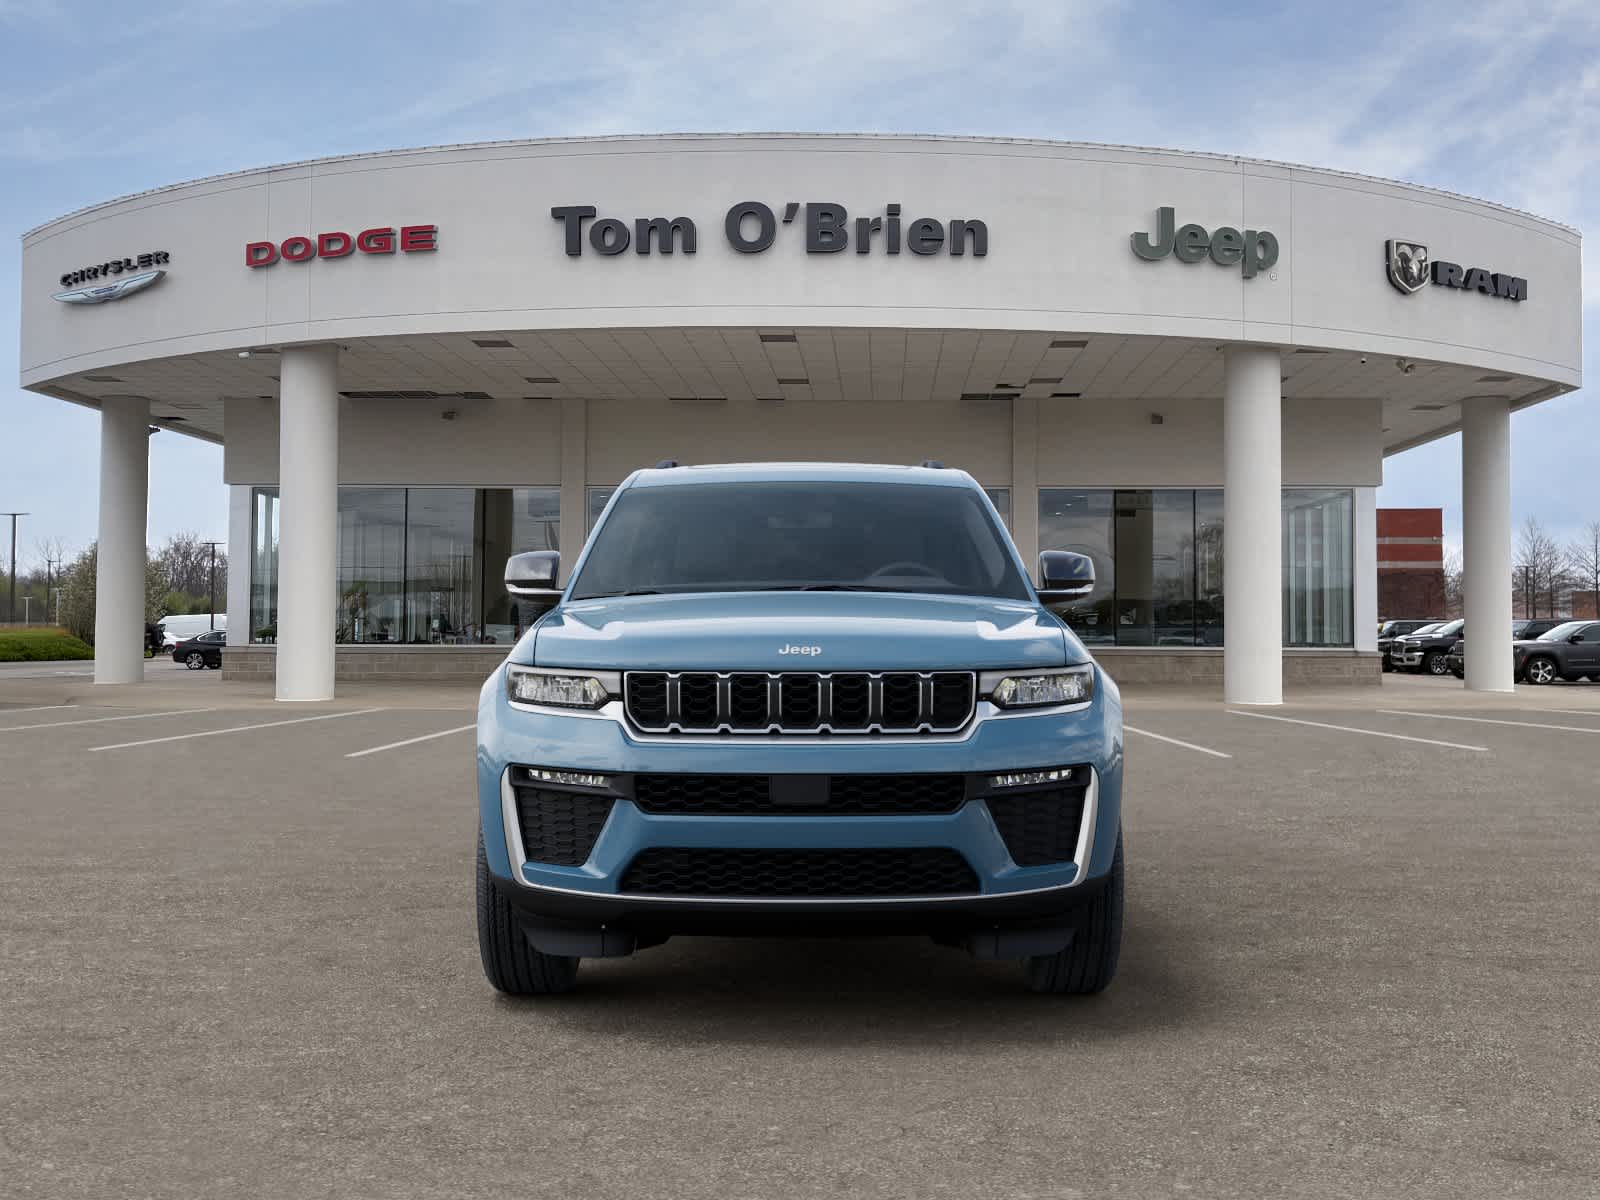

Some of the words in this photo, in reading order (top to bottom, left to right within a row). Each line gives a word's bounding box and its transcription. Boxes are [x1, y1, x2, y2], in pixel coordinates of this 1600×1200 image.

[245, 224, 438, 268] DODGE
[551, 205, 697, 257] Tom
[725, 201, 988, 257] O'Brien
[1130, 207, 1279, 279] Jeep
[60, 250, 169, 287] CHRYSLER
[1431, 261, 1528, 301] RAM
[778, 643, 822, 656] Jeep
